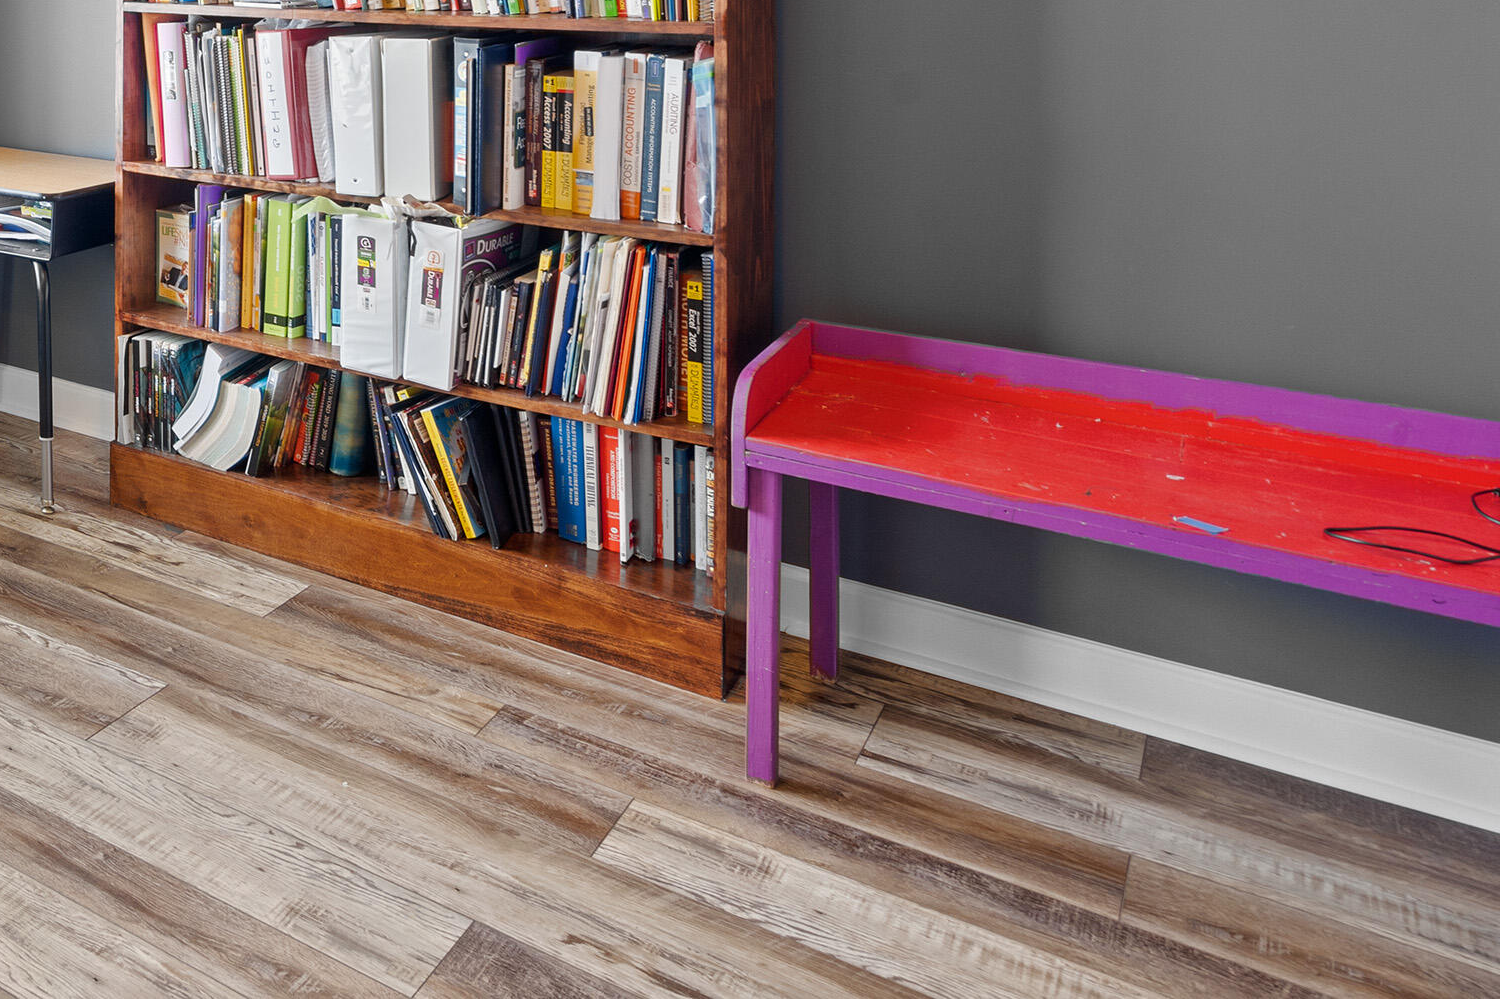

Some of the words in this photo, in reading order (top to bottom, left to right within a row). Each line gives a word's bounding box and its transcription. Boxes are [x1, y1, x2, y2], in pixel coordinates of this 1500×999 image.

[542, 96, 552, 125] Access
[561, 100, 573, 145] Accounting
[625, 87, 636, 157] ACCOUNTING
[649, 98, 657, 134] ACCOUNTING
[669, 92, 679, 135] AUDITING
[542, 126, 552, 150] 2007
[623, 160, 632, 186] COST
[476, 232, 514, 255] DURABLE
[688, 308, 697, 329] Excel
[688, 331, 697, 353] 2007
[690, 369, 699, 410] DUMMIES
[544, 429, 552, 461] HANDBOOK
[548, 469, 556, 506] HYDRAULICS
[586, 445, 594, 479] TECHNICAL
[587, 481, 596, 508] EDITING
